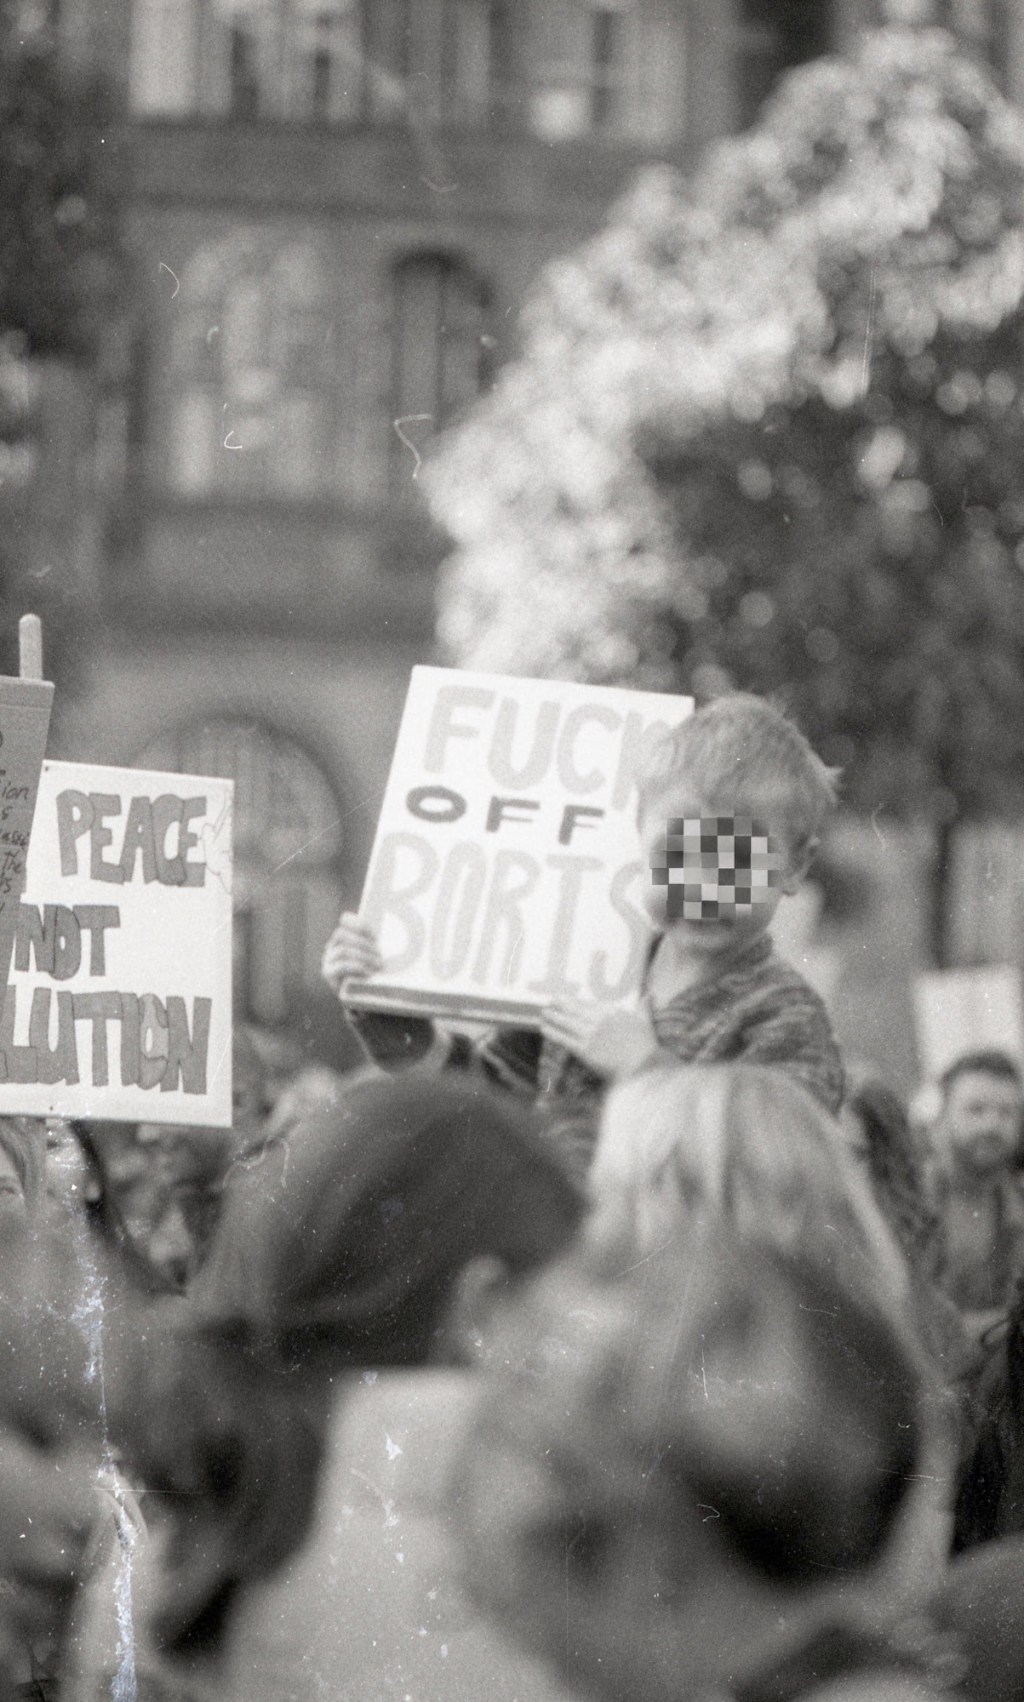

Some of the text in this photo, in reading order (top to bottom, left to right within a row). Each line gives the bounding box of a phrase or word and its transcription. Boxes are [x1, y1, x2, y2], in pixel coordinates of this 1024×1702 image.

[56, 789, 207, 888] PEACE
[405, 785, 605, 846] OFF
[14, 904, 121, 981] NOT
[363, 831, 652, 1001] BORIS
[0, 984, 212, 1095] LUTION
